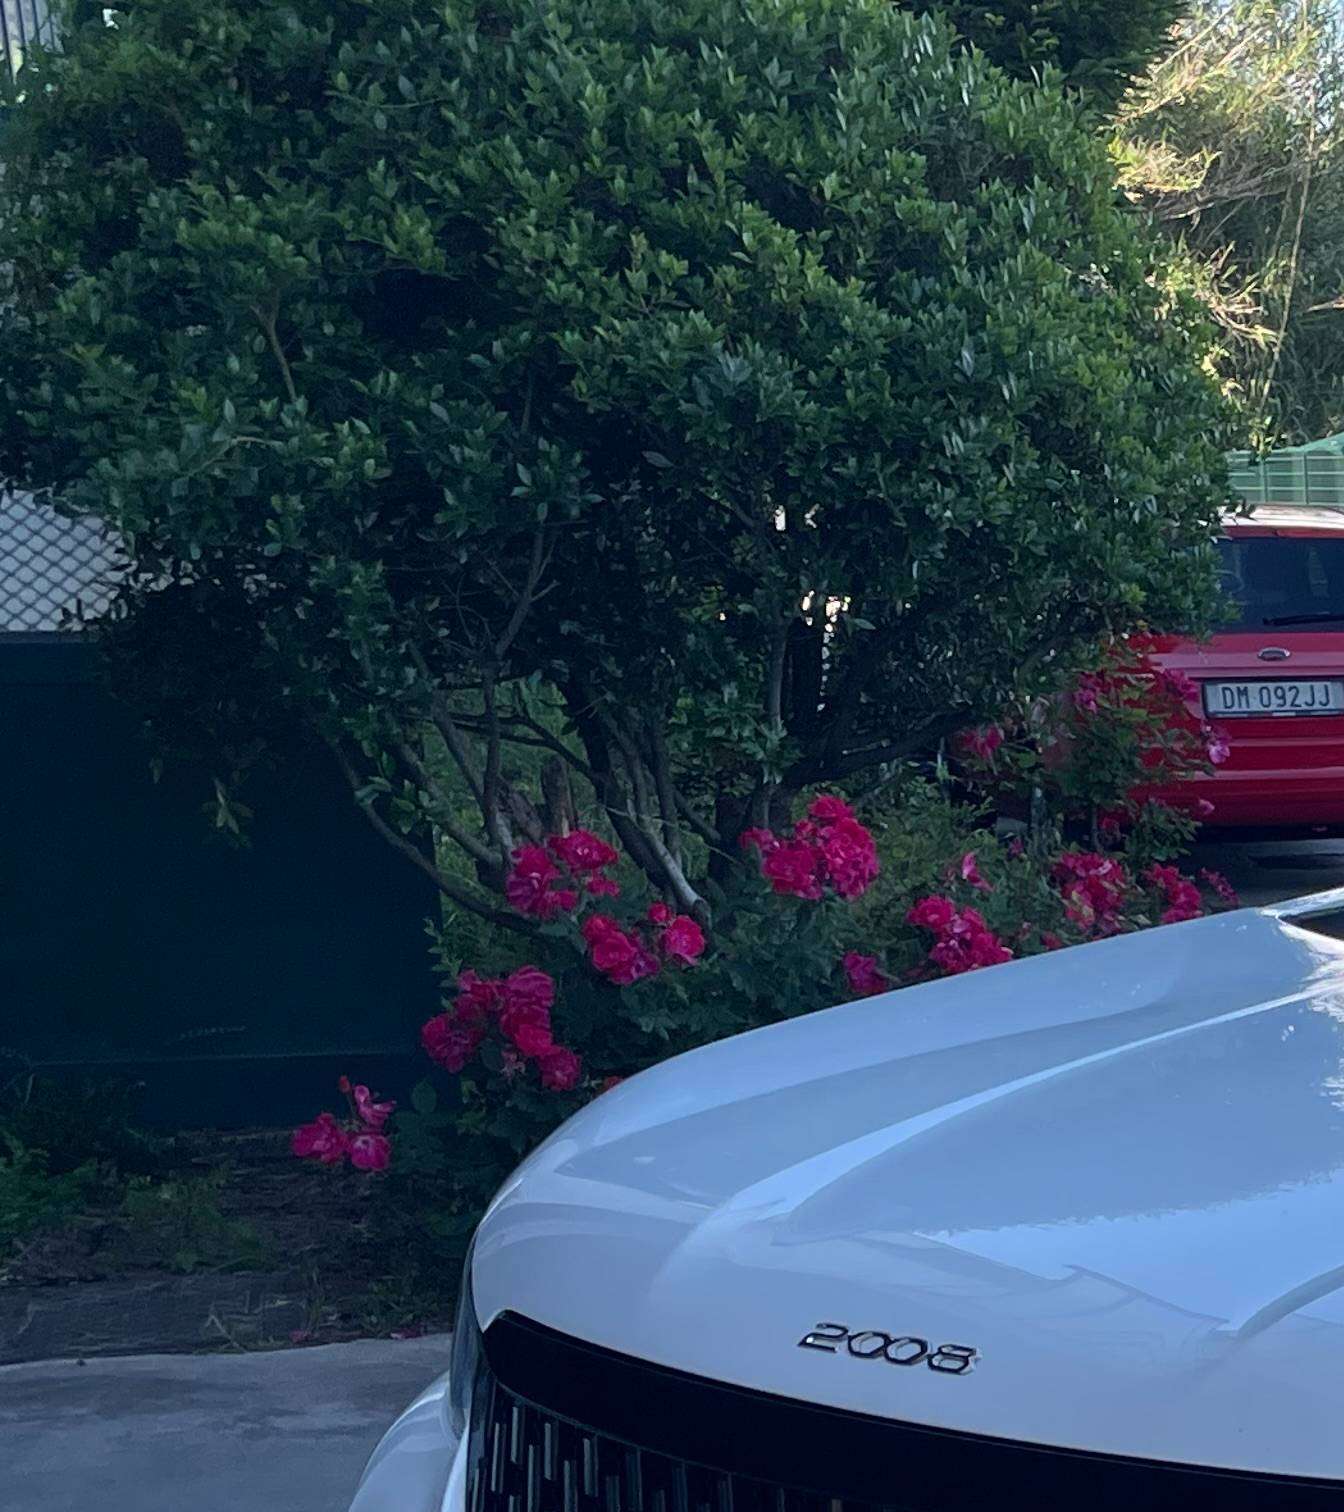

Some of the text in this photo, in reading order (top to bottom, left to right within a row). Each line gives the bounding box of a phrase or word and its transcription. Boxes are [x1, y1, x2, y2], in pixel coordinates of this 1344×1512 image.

[1221, 684, 1331, 709] DM 092JJ
[798, 1322, 981, 1376] 2008
